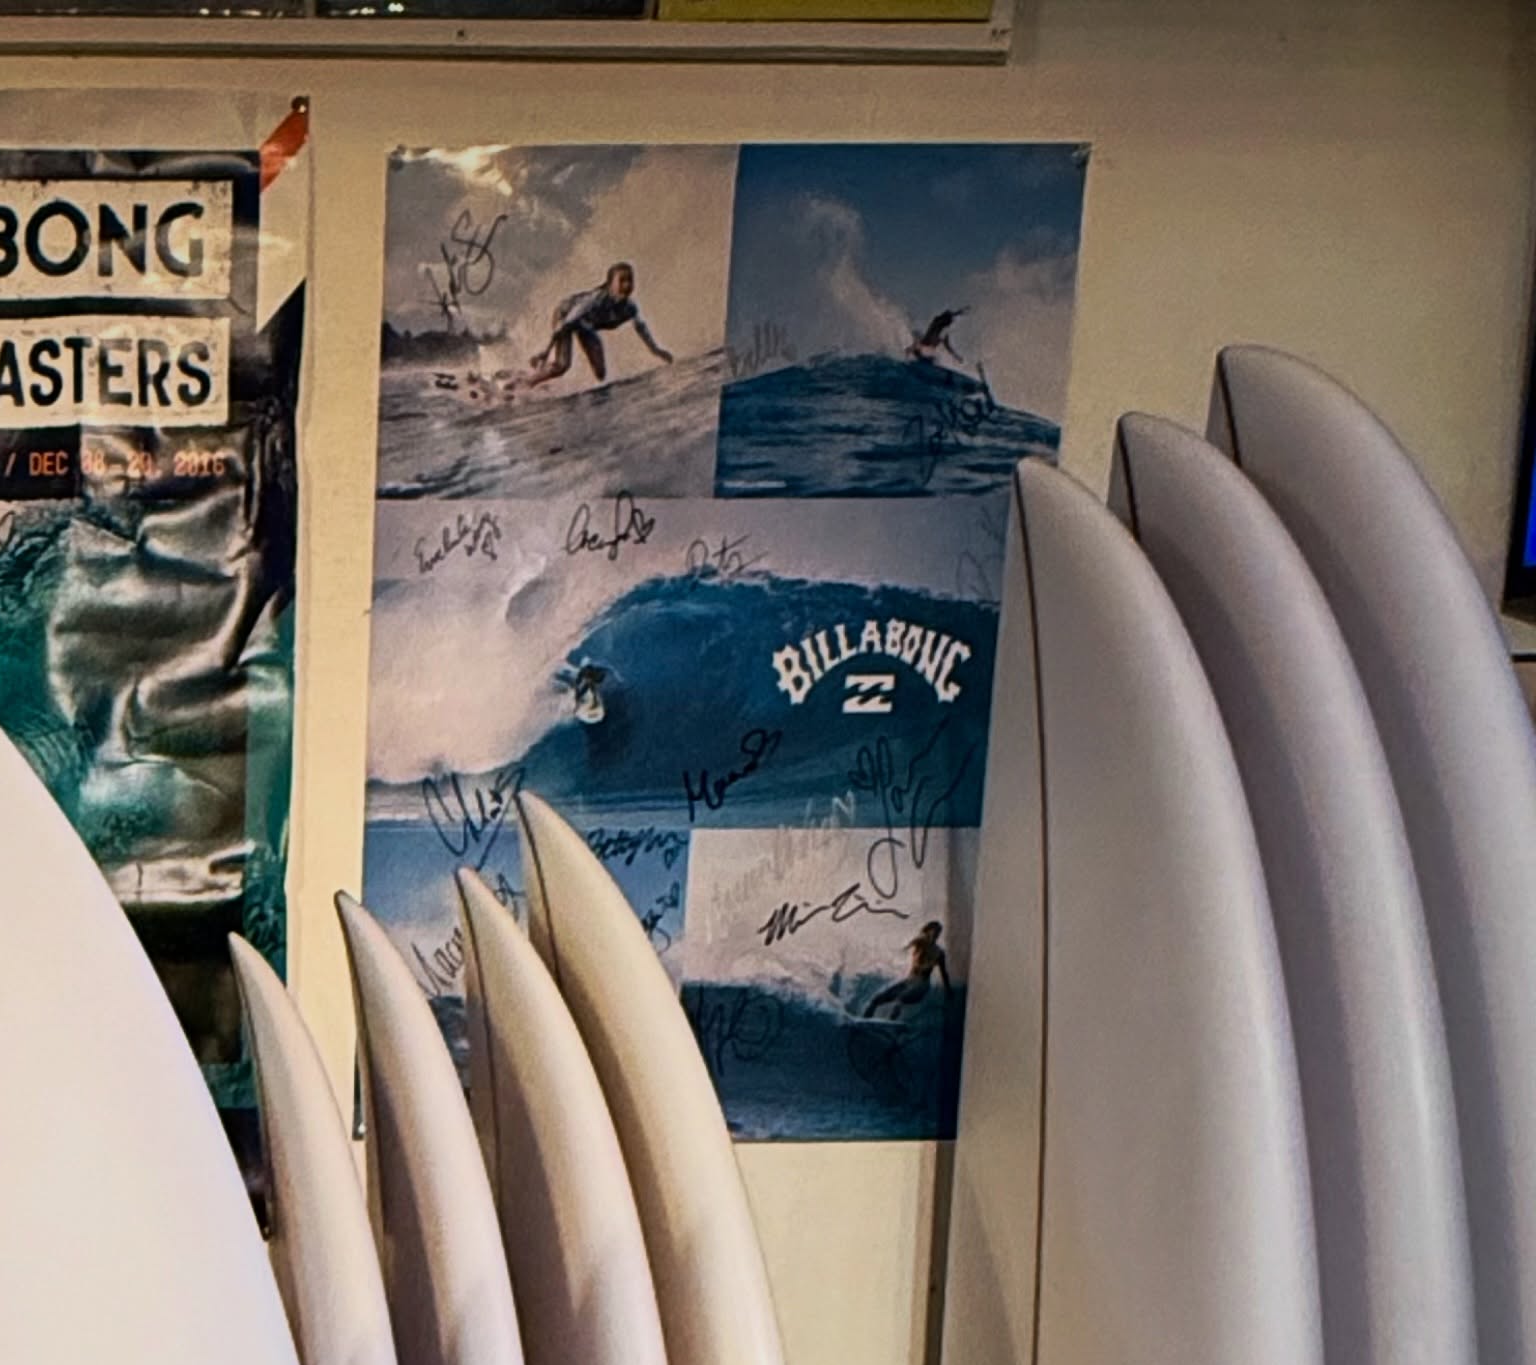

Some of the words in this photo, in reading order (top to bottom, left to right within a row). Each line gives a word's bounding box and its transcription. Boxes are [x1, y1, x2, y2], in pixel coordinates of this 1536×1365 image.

[29, 452, 68, 475] DEC
[173, 452, 226, 477] 2016
[772, 617, 971, 706] BILLABONG
